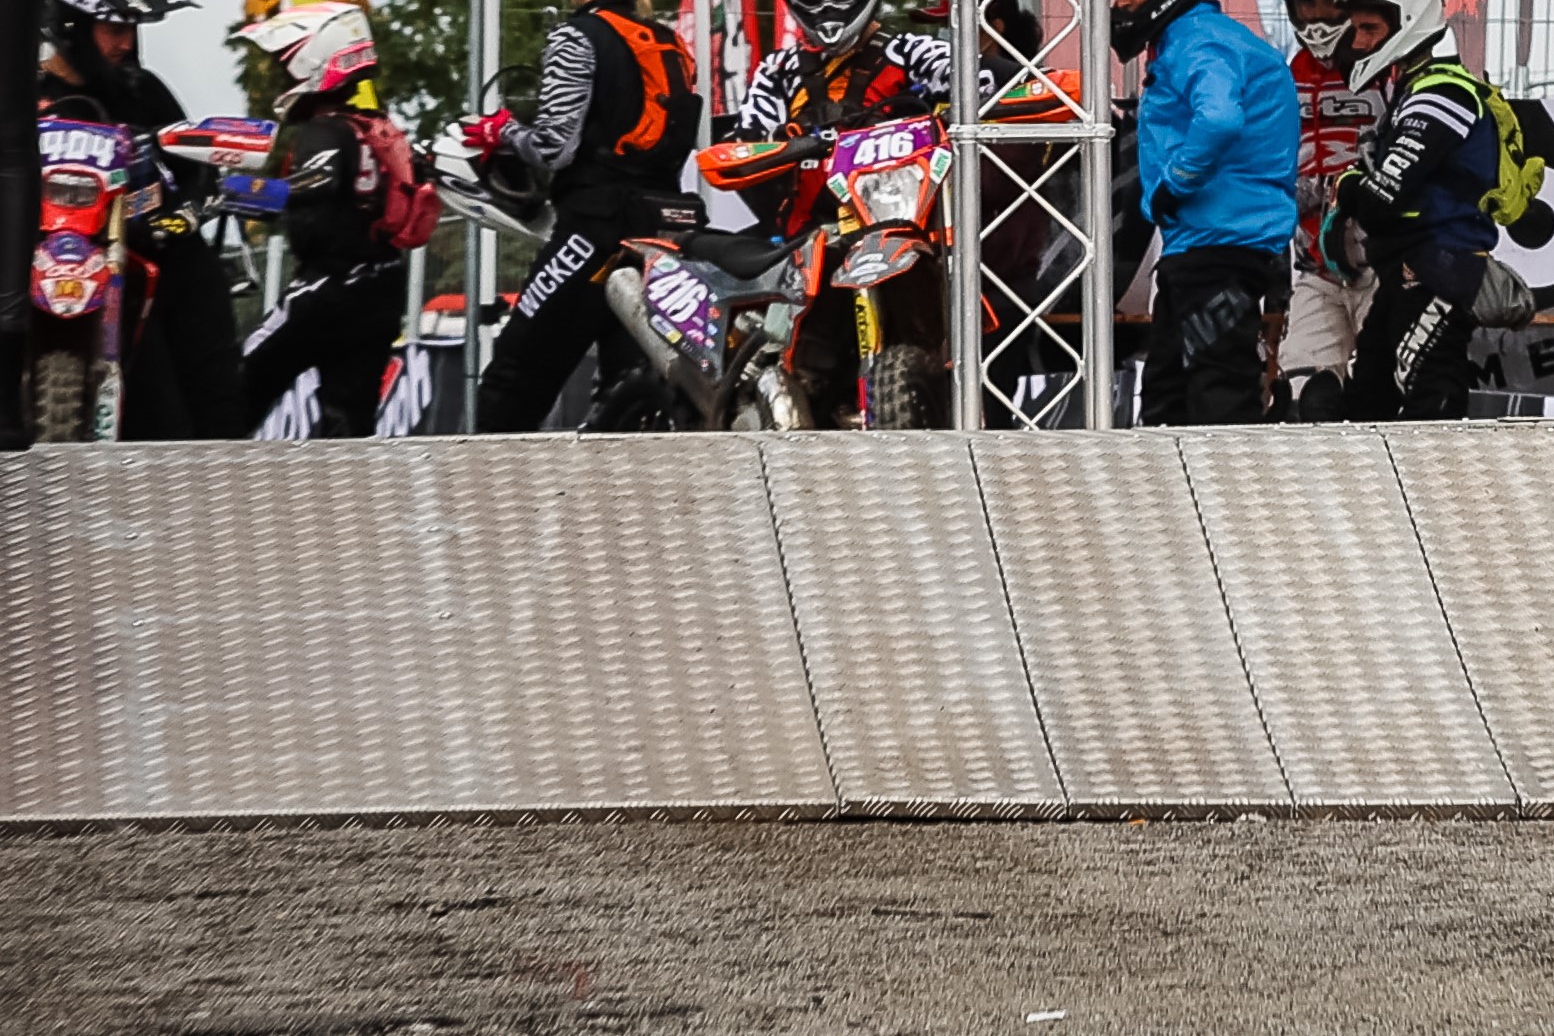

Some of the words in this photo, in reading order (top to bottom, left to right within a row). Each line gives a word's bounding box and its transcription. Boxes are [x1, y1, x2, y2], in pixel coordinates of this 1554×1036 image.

[853, 131, 915, 165] 416
[517, 233, 595, 319] WICKED
[647, 269, 709, 323] 416
